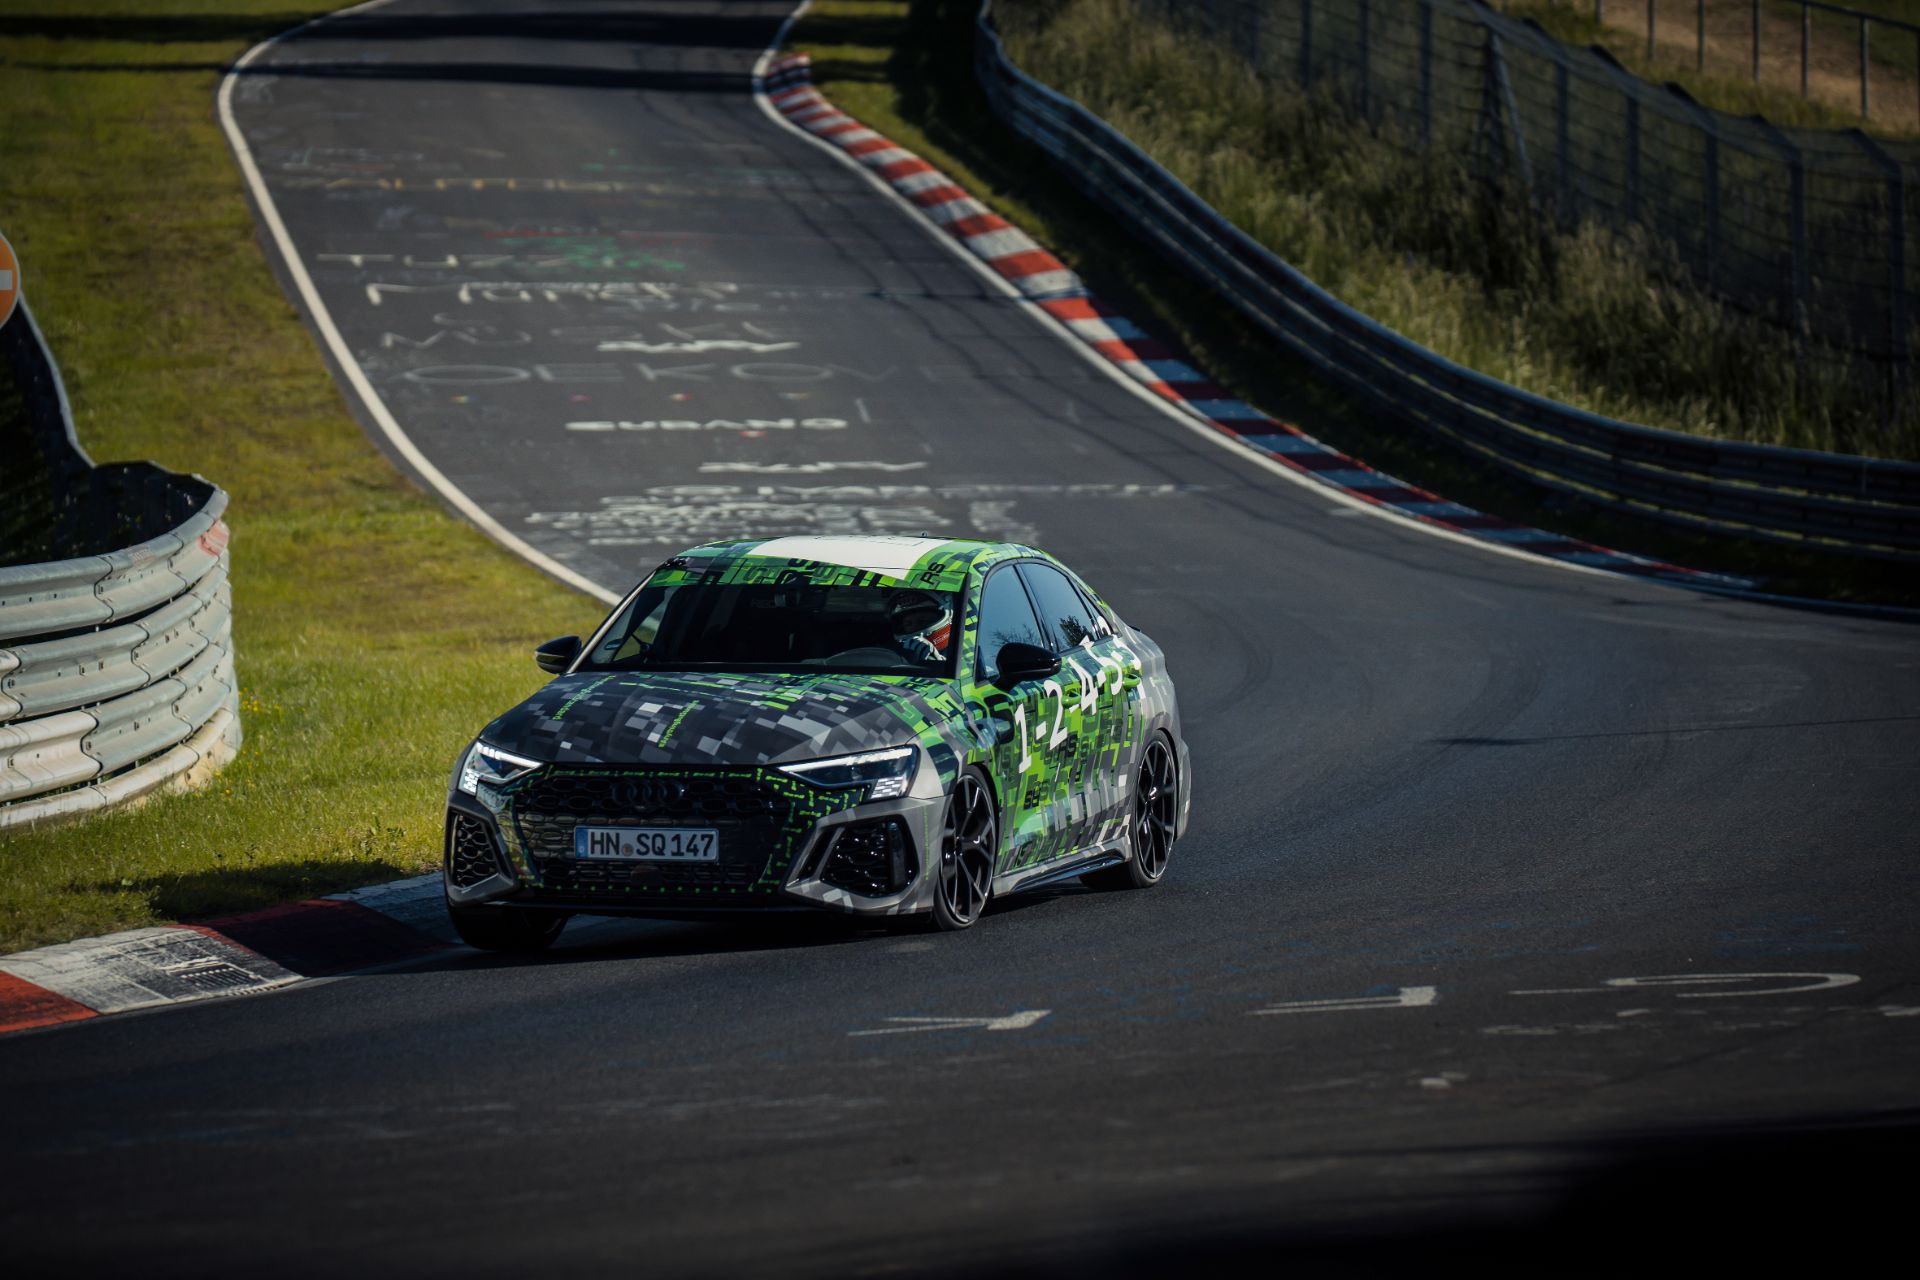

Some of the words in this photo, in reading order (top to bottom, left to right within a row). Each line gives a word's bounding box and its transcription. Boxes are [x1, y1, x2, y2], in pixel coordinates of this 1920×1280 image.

[590, 831, 620, 855] HN
[636, 833, 666, 857] SQ
[671, 833, 715, 857] 147
